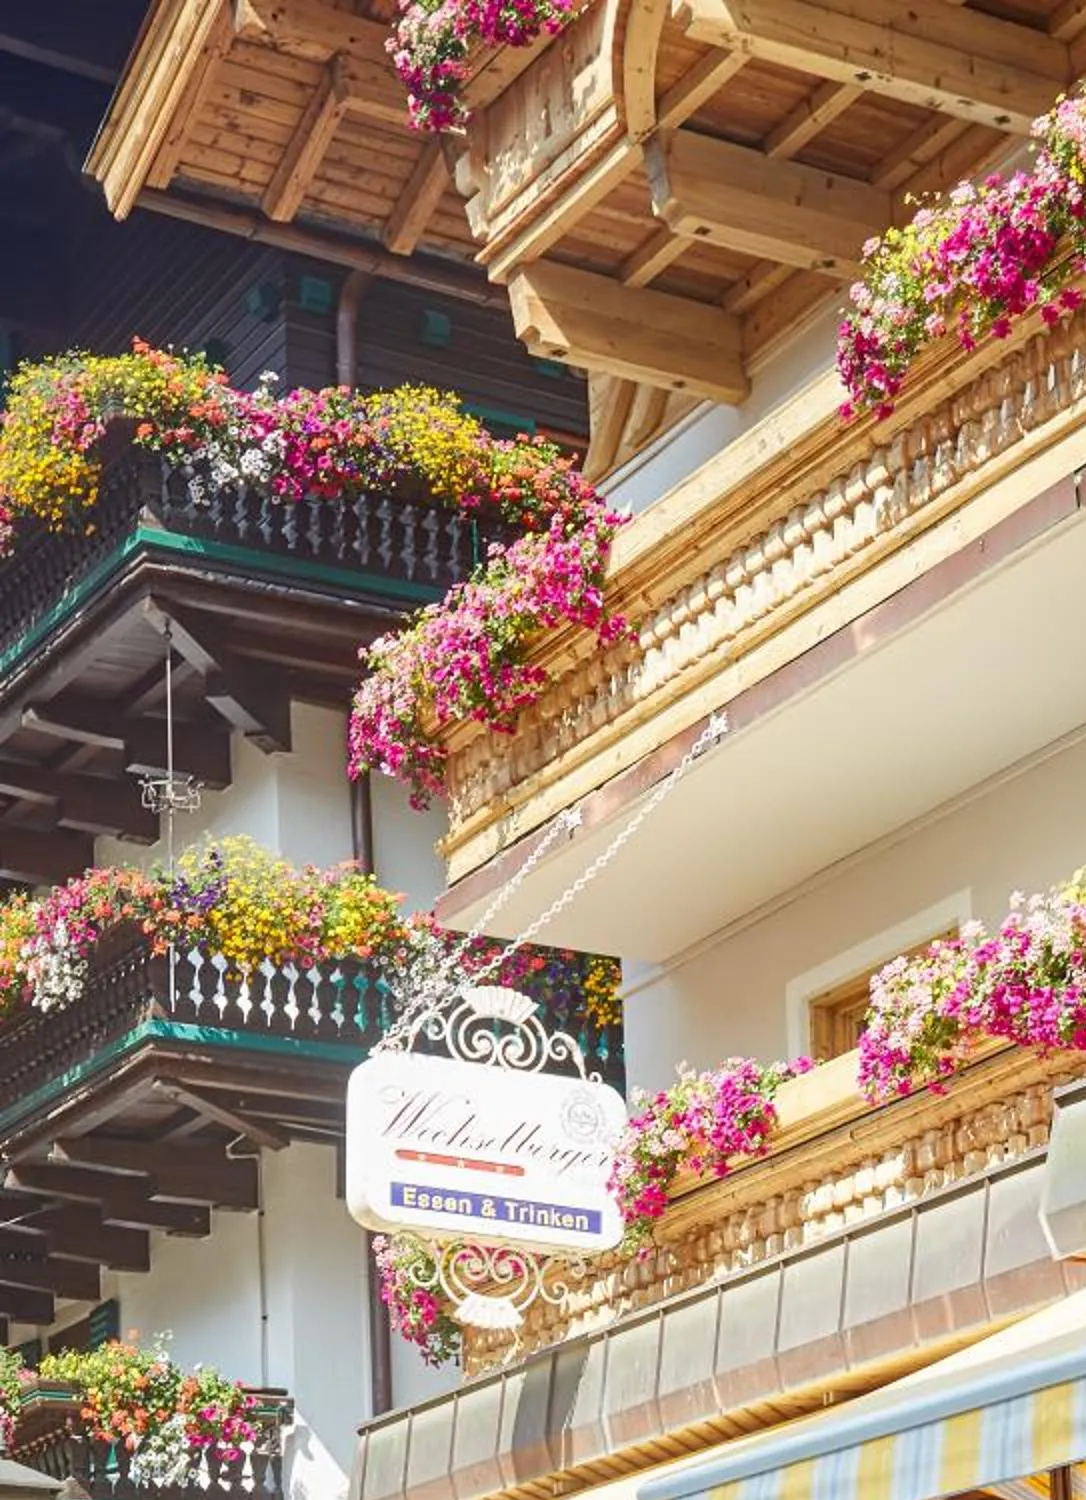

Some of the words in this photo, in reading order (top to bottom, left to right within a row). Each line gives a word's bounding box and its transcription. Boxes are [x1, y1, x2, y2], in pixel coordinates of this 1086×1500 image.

[403, 1187, 472, 1214] Essen
[481, 1199, 497, 1218] &
[505, 1202, 589, 1230] Trinken
